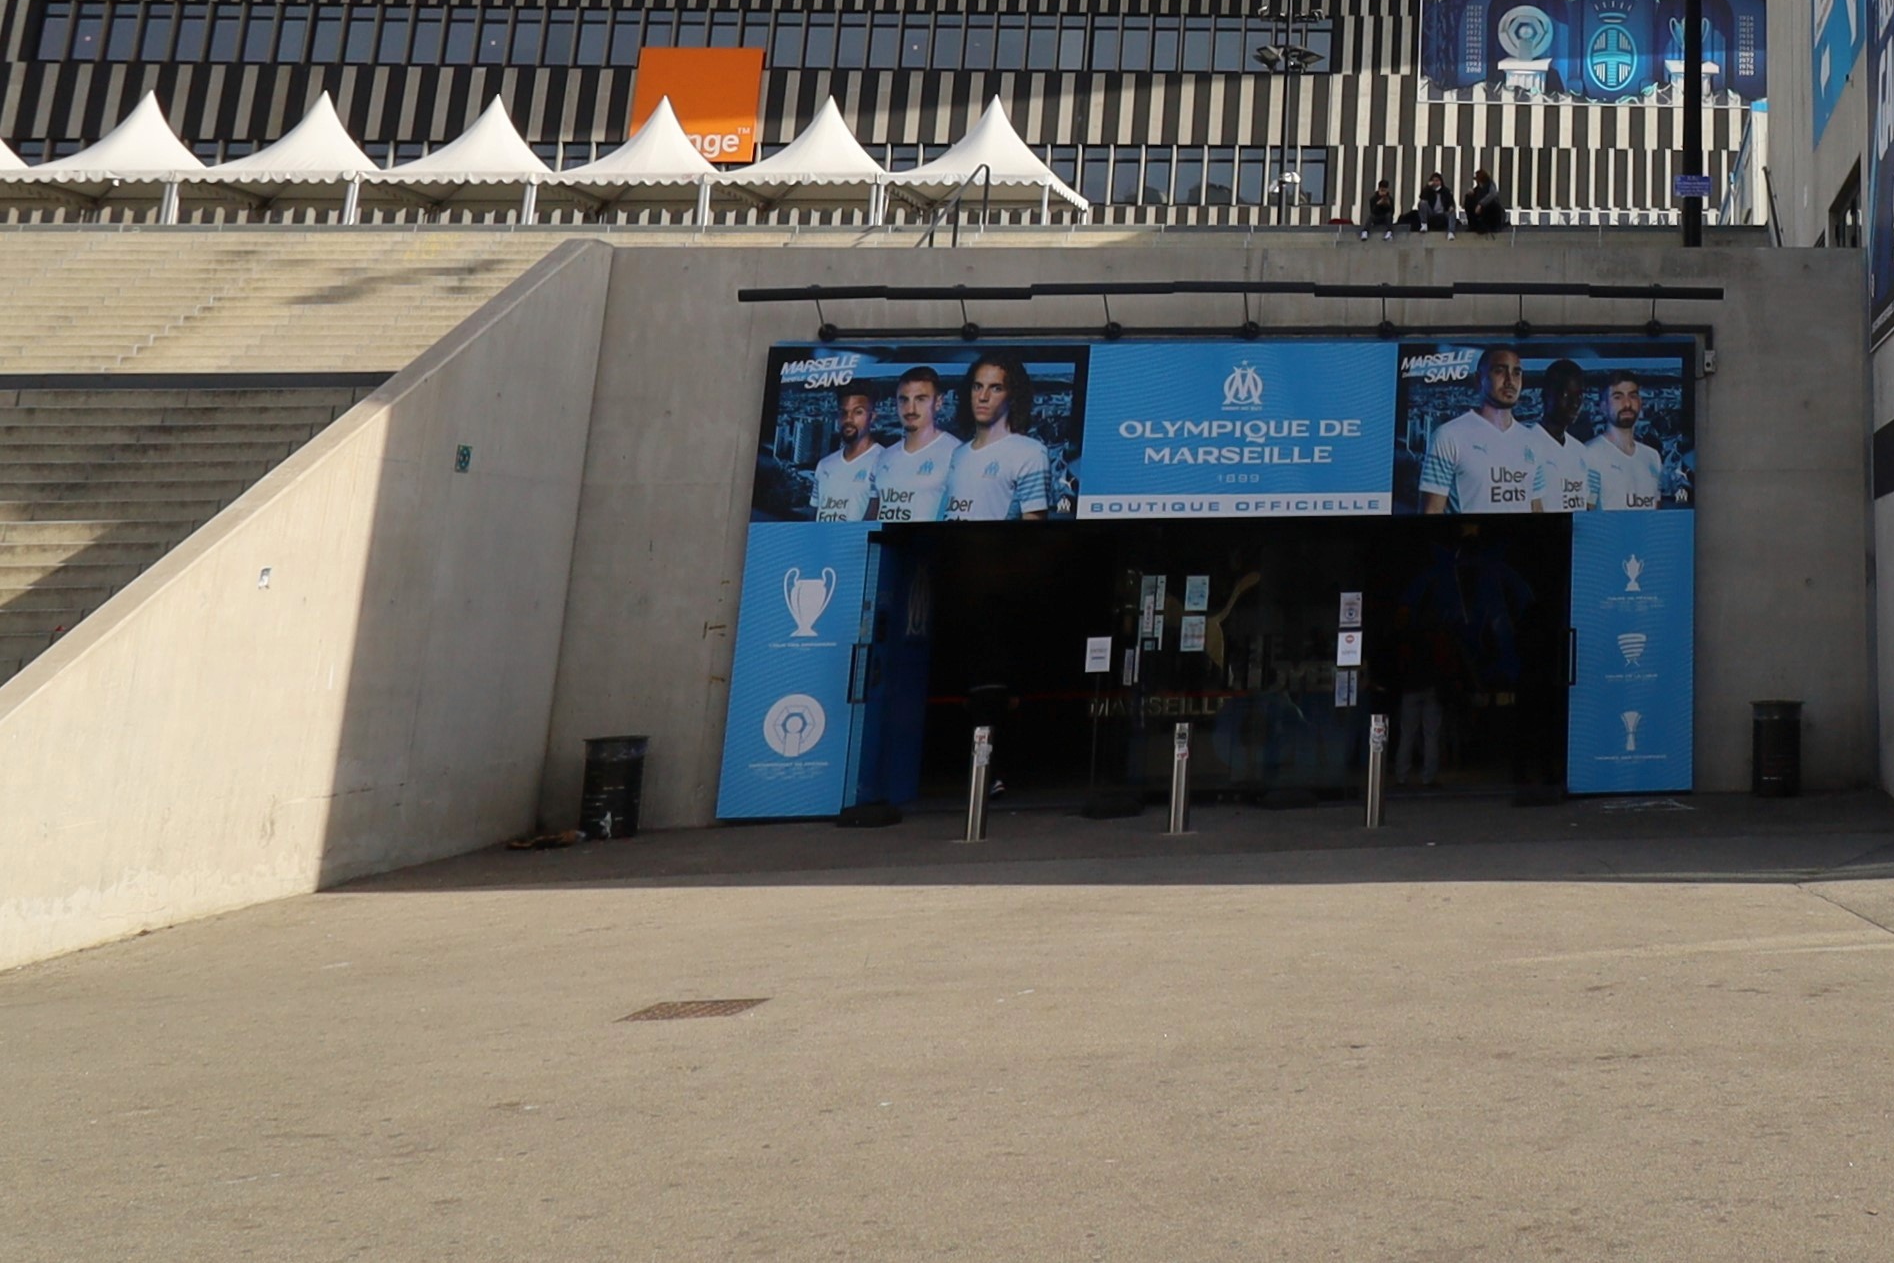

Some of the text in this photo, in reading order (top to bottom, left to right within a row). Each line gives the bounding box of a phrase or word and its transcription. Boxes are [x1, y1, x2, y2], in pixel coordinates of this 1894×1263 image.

[780, 354, 862, 375] MARSEILLE
[1401, 349, 1477, 370] MARSEILLE
[804, 369, 854, 390] SANG
[1424, 365, 1470, 383] SANG
[1118, 419, 1362, 443] OLYMPIQUE DE
[1144, 446, 1333, 465] MARSEILLE
[1490, 466, 1528, 483] Uber
[880, 488, 915, 504] Uber
[1490, 486, 1527, 503] Eats
[1626, 493, 1656, 508] Uber
[878, 505, 912, 521] Eats
[1090, 499, 1381, 513] BOUTIQUE OFFICIELLE
